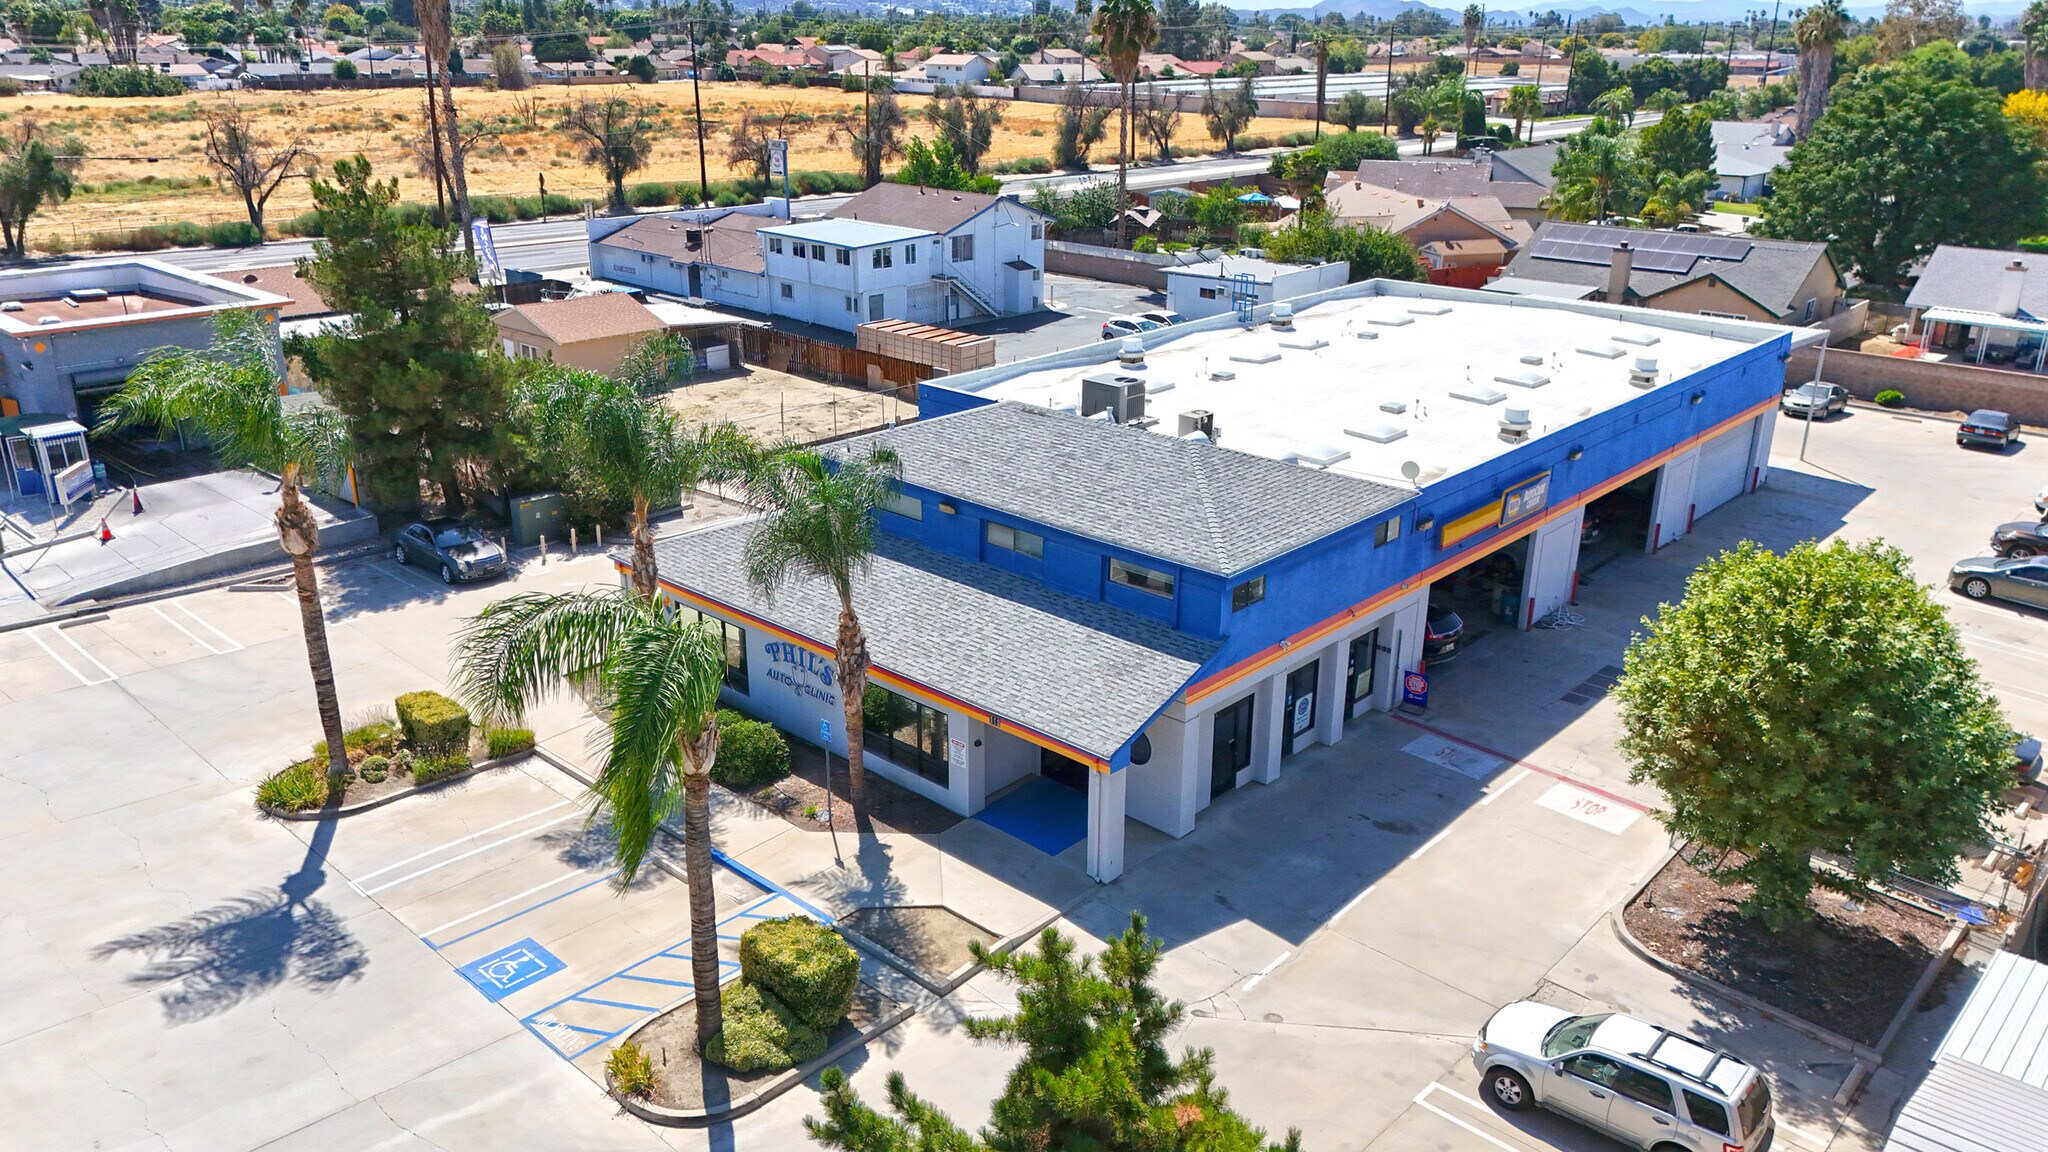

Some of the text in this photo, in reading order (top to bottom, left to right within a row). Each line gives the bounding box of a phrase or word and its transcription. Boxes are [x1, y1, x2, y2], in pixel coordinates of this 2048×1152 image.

[765, 641, 835, 687] PHIL'S
[766, 668, 837, 706] AUTO CLINIC
[1570, 797, 1608, 816] STOP
[534, 1012, 560, 1029] NO
